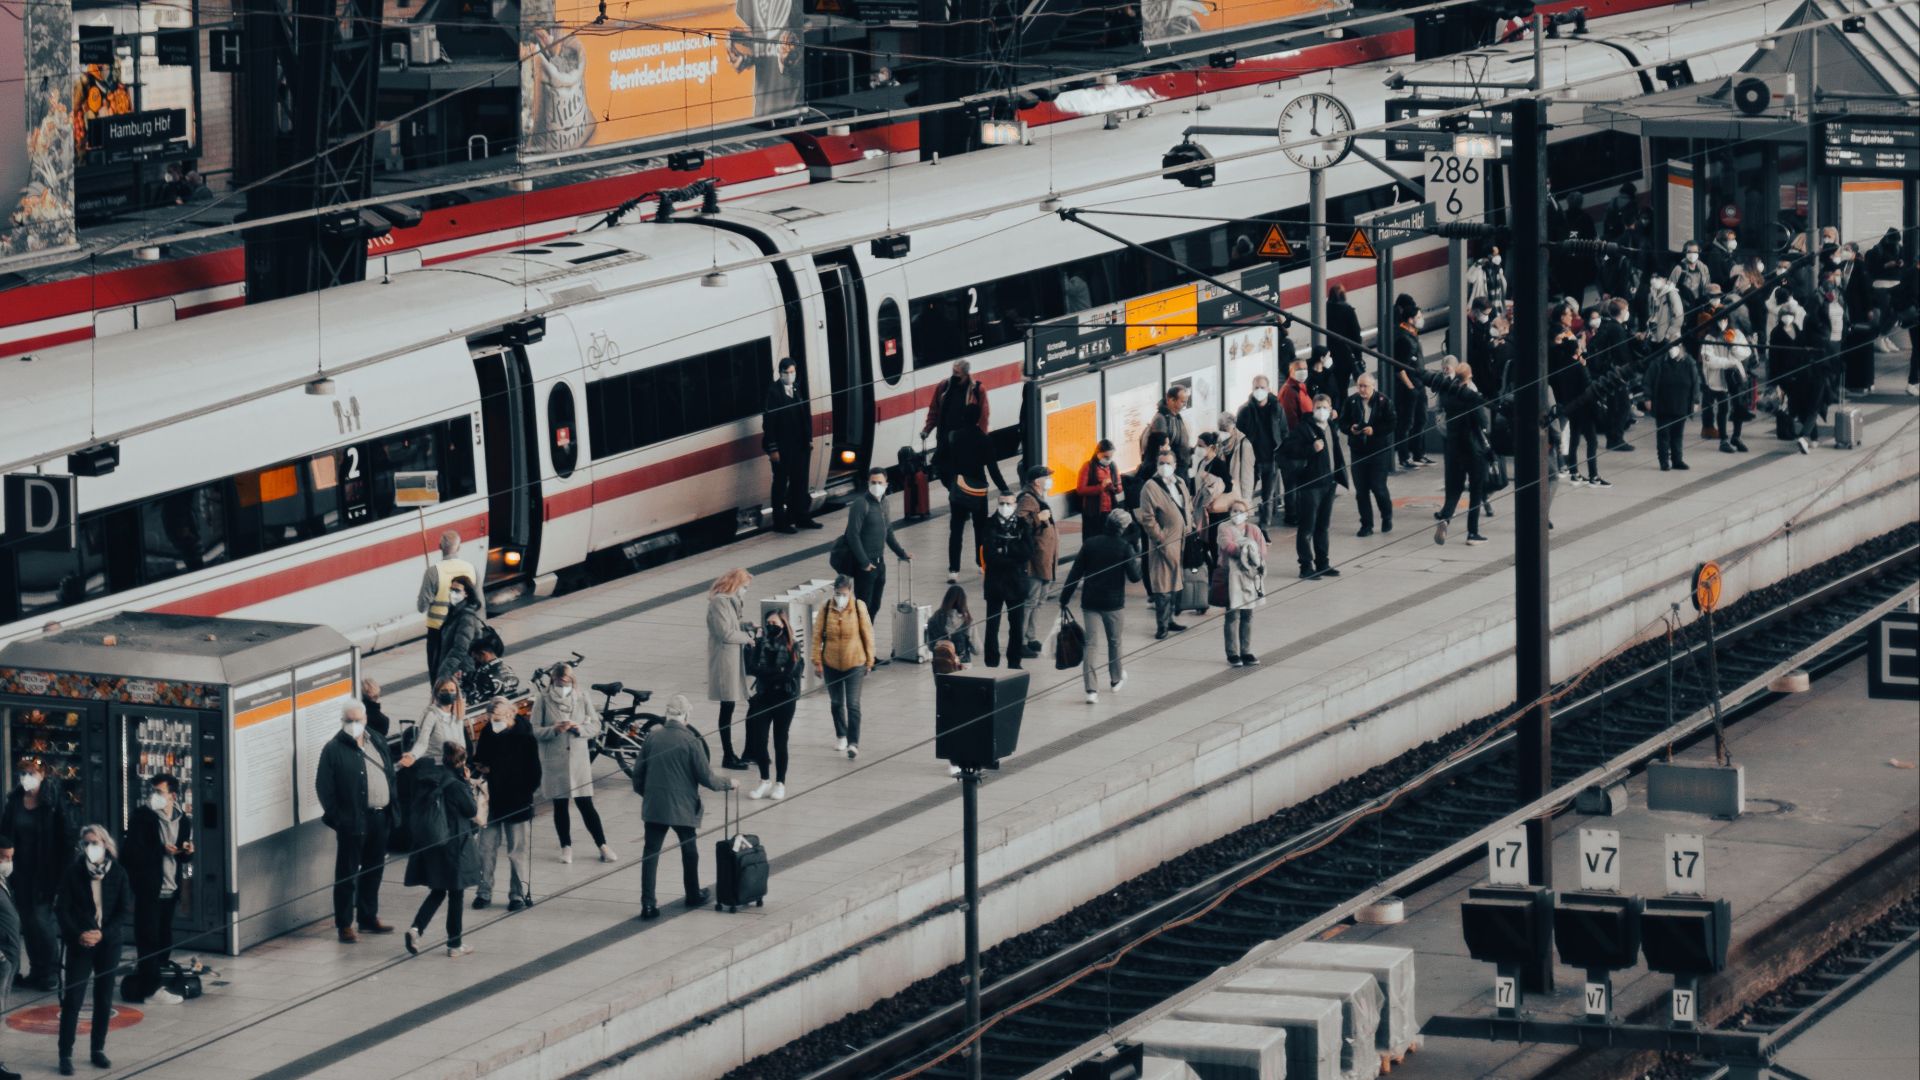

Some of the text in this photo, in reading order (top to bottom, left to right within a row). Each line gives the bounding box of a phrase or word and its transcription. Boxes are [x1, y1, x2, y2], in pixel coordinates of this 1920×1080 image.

[222, 34, 240, 65] H
[609, 55, 718, 91] #entdeckedasgut
[109, 115, 171, 139] Hamburg Hbf
[1429, 155, 1479, 184] 286
[1446, 188, 1463, 215] 6
[1378, 211, 1425, 240] Hamburg Hbf
[967, 287, 979, 314] 2
[347, 446, 360, 479] 2
[24, 478, 60, 534] D
[1881, 620, 1919, 685] E
[1495, 841, 1522, 868] r7
[1585, 847, 1617, 873] v7
[1672, 851, 1699, 878] t7
[1498, 982, 1513, 1003] r7
[1587, 988, 1604, 1009] v7
[1676, 994, 1690, 1015] t7
